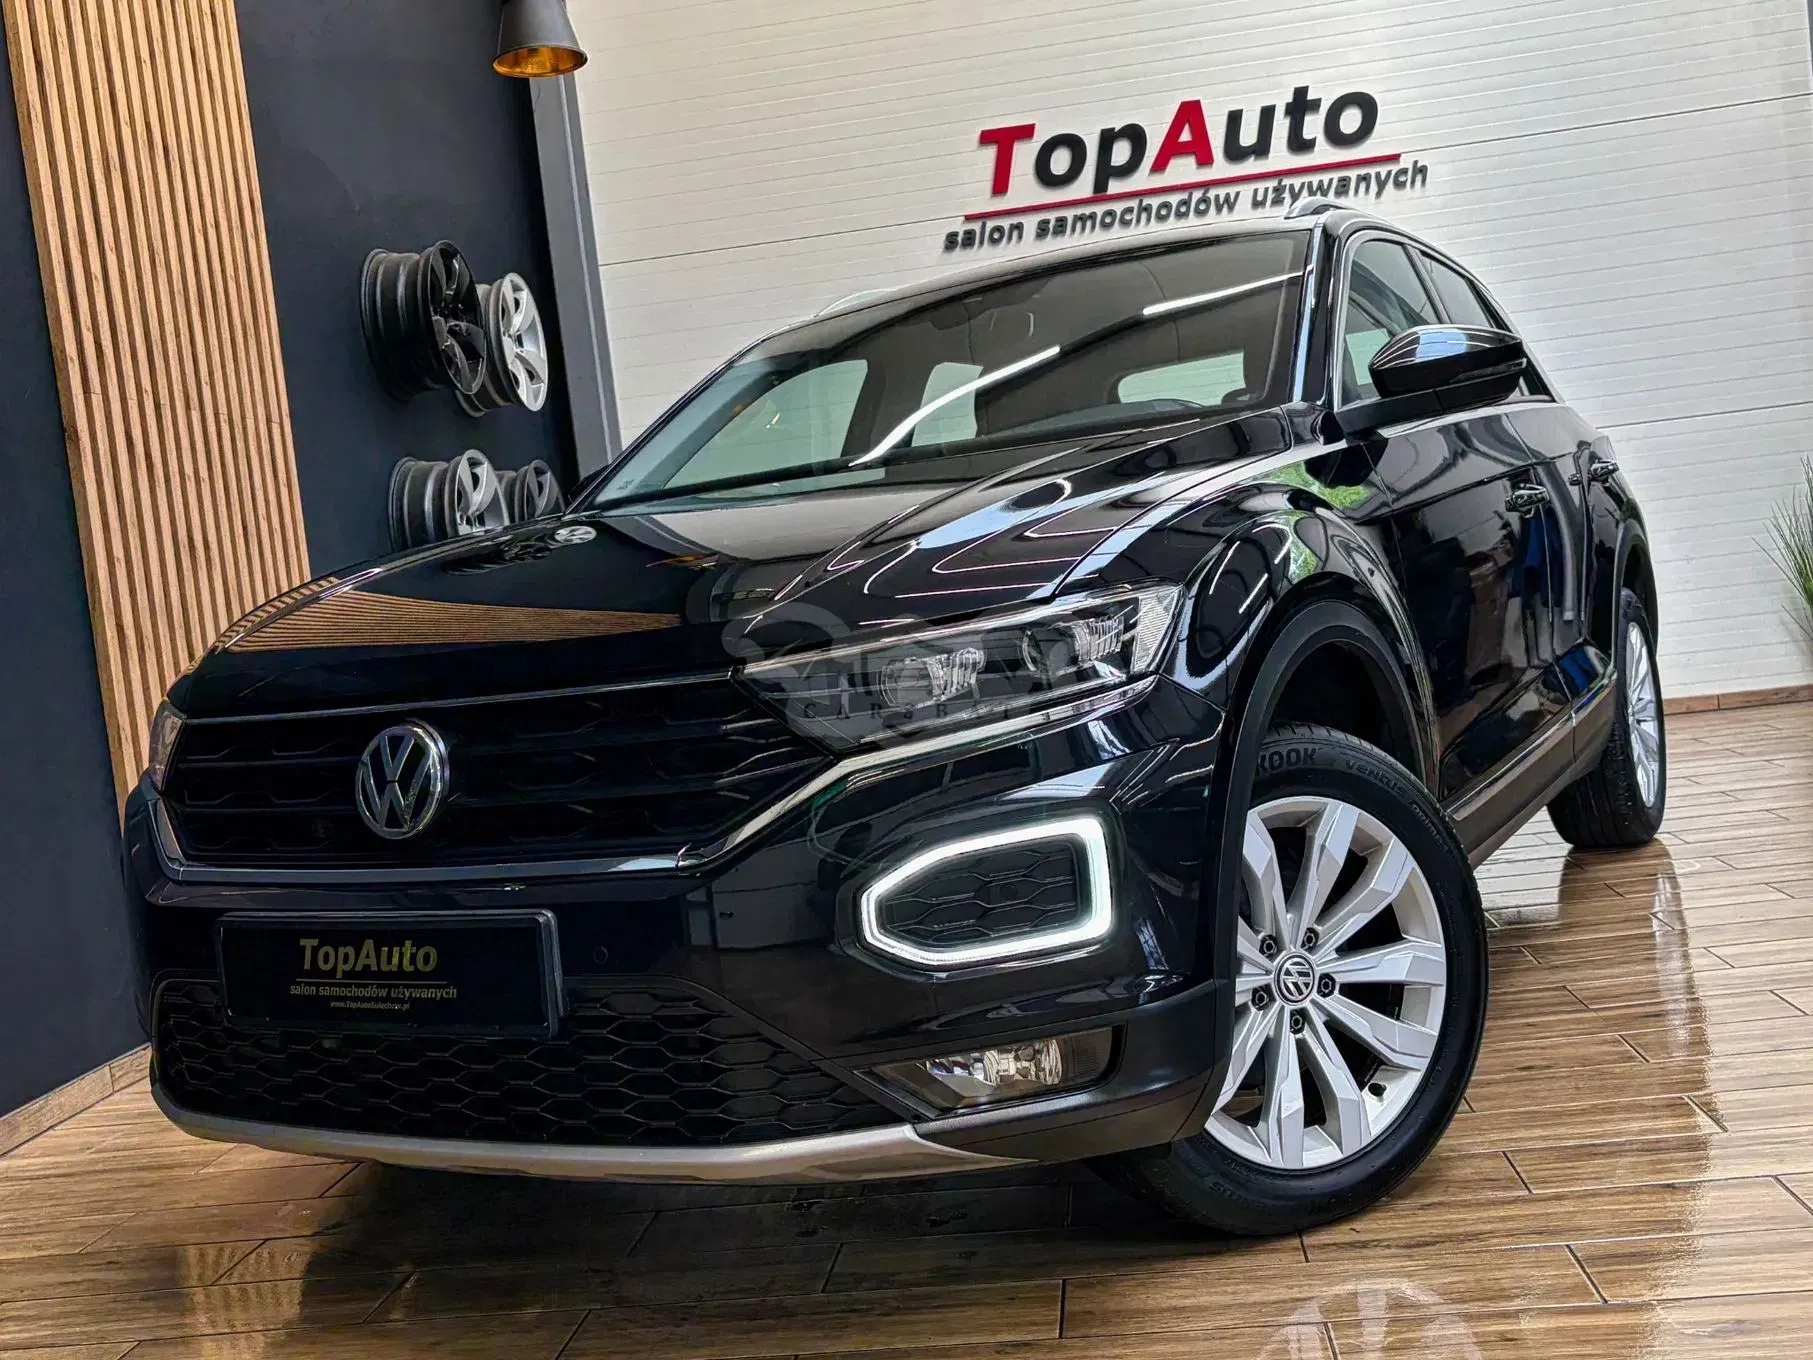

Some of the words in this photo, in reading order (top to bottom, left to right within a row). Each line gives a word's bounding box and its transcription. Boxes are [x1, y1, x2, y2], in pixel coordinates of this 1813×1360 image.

[978, 86, 1380, 196] TopAuto
[944, 219, 1024, 252] salon
[1035, 188, 1241, 239] samochodów
[1251, 160, 1429, 210] używanych
[299, 938, 438, 978] TopAuto
[289, 983, 317, 997] salon
[318, 984, 389, 998] samochodów
[390, 985, 457, 1001] używanych
